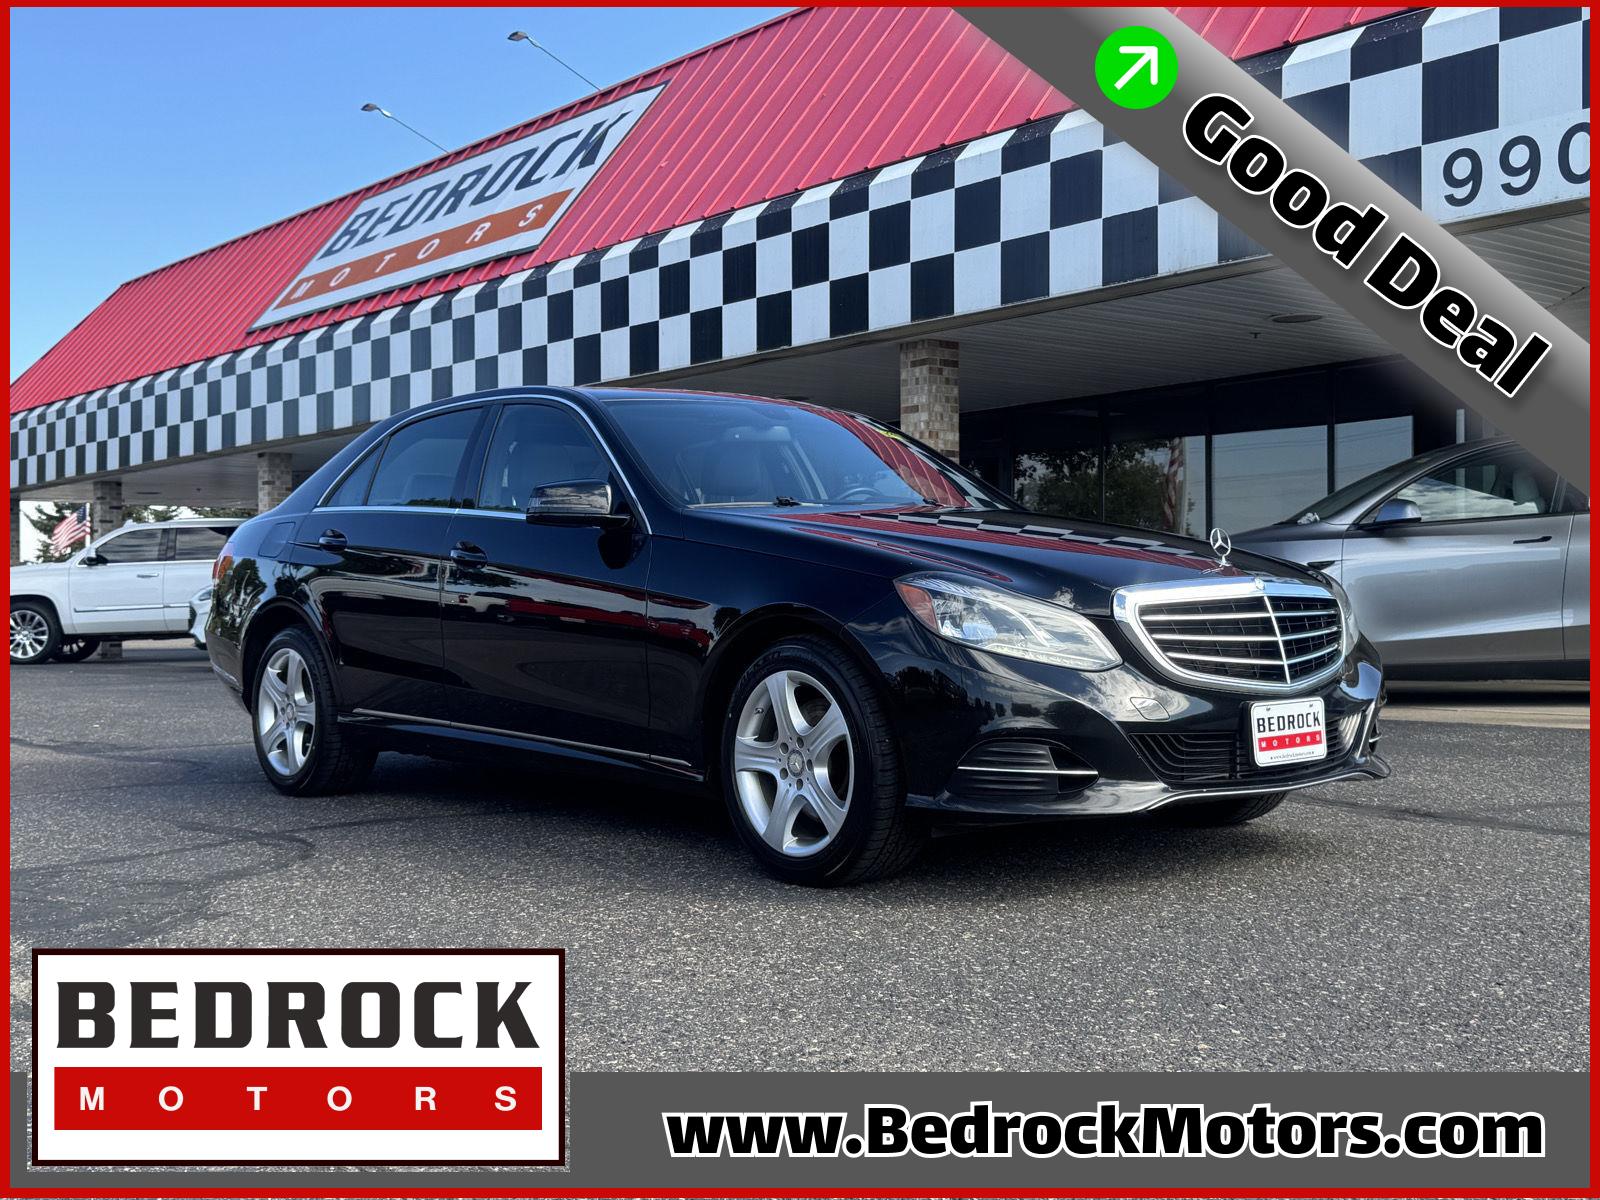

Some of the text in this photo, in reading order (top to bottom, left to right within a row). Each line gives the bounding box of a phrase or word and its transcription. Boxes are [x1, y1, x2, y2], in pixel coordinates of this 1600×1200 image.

[316, 110, 633, 260] BEDROCK
[290, 203, 544, 300] MOTORS
[1257, 711, 1321, 733] BEDROCK
[1261, 734, 1320, 748] MOTORS
